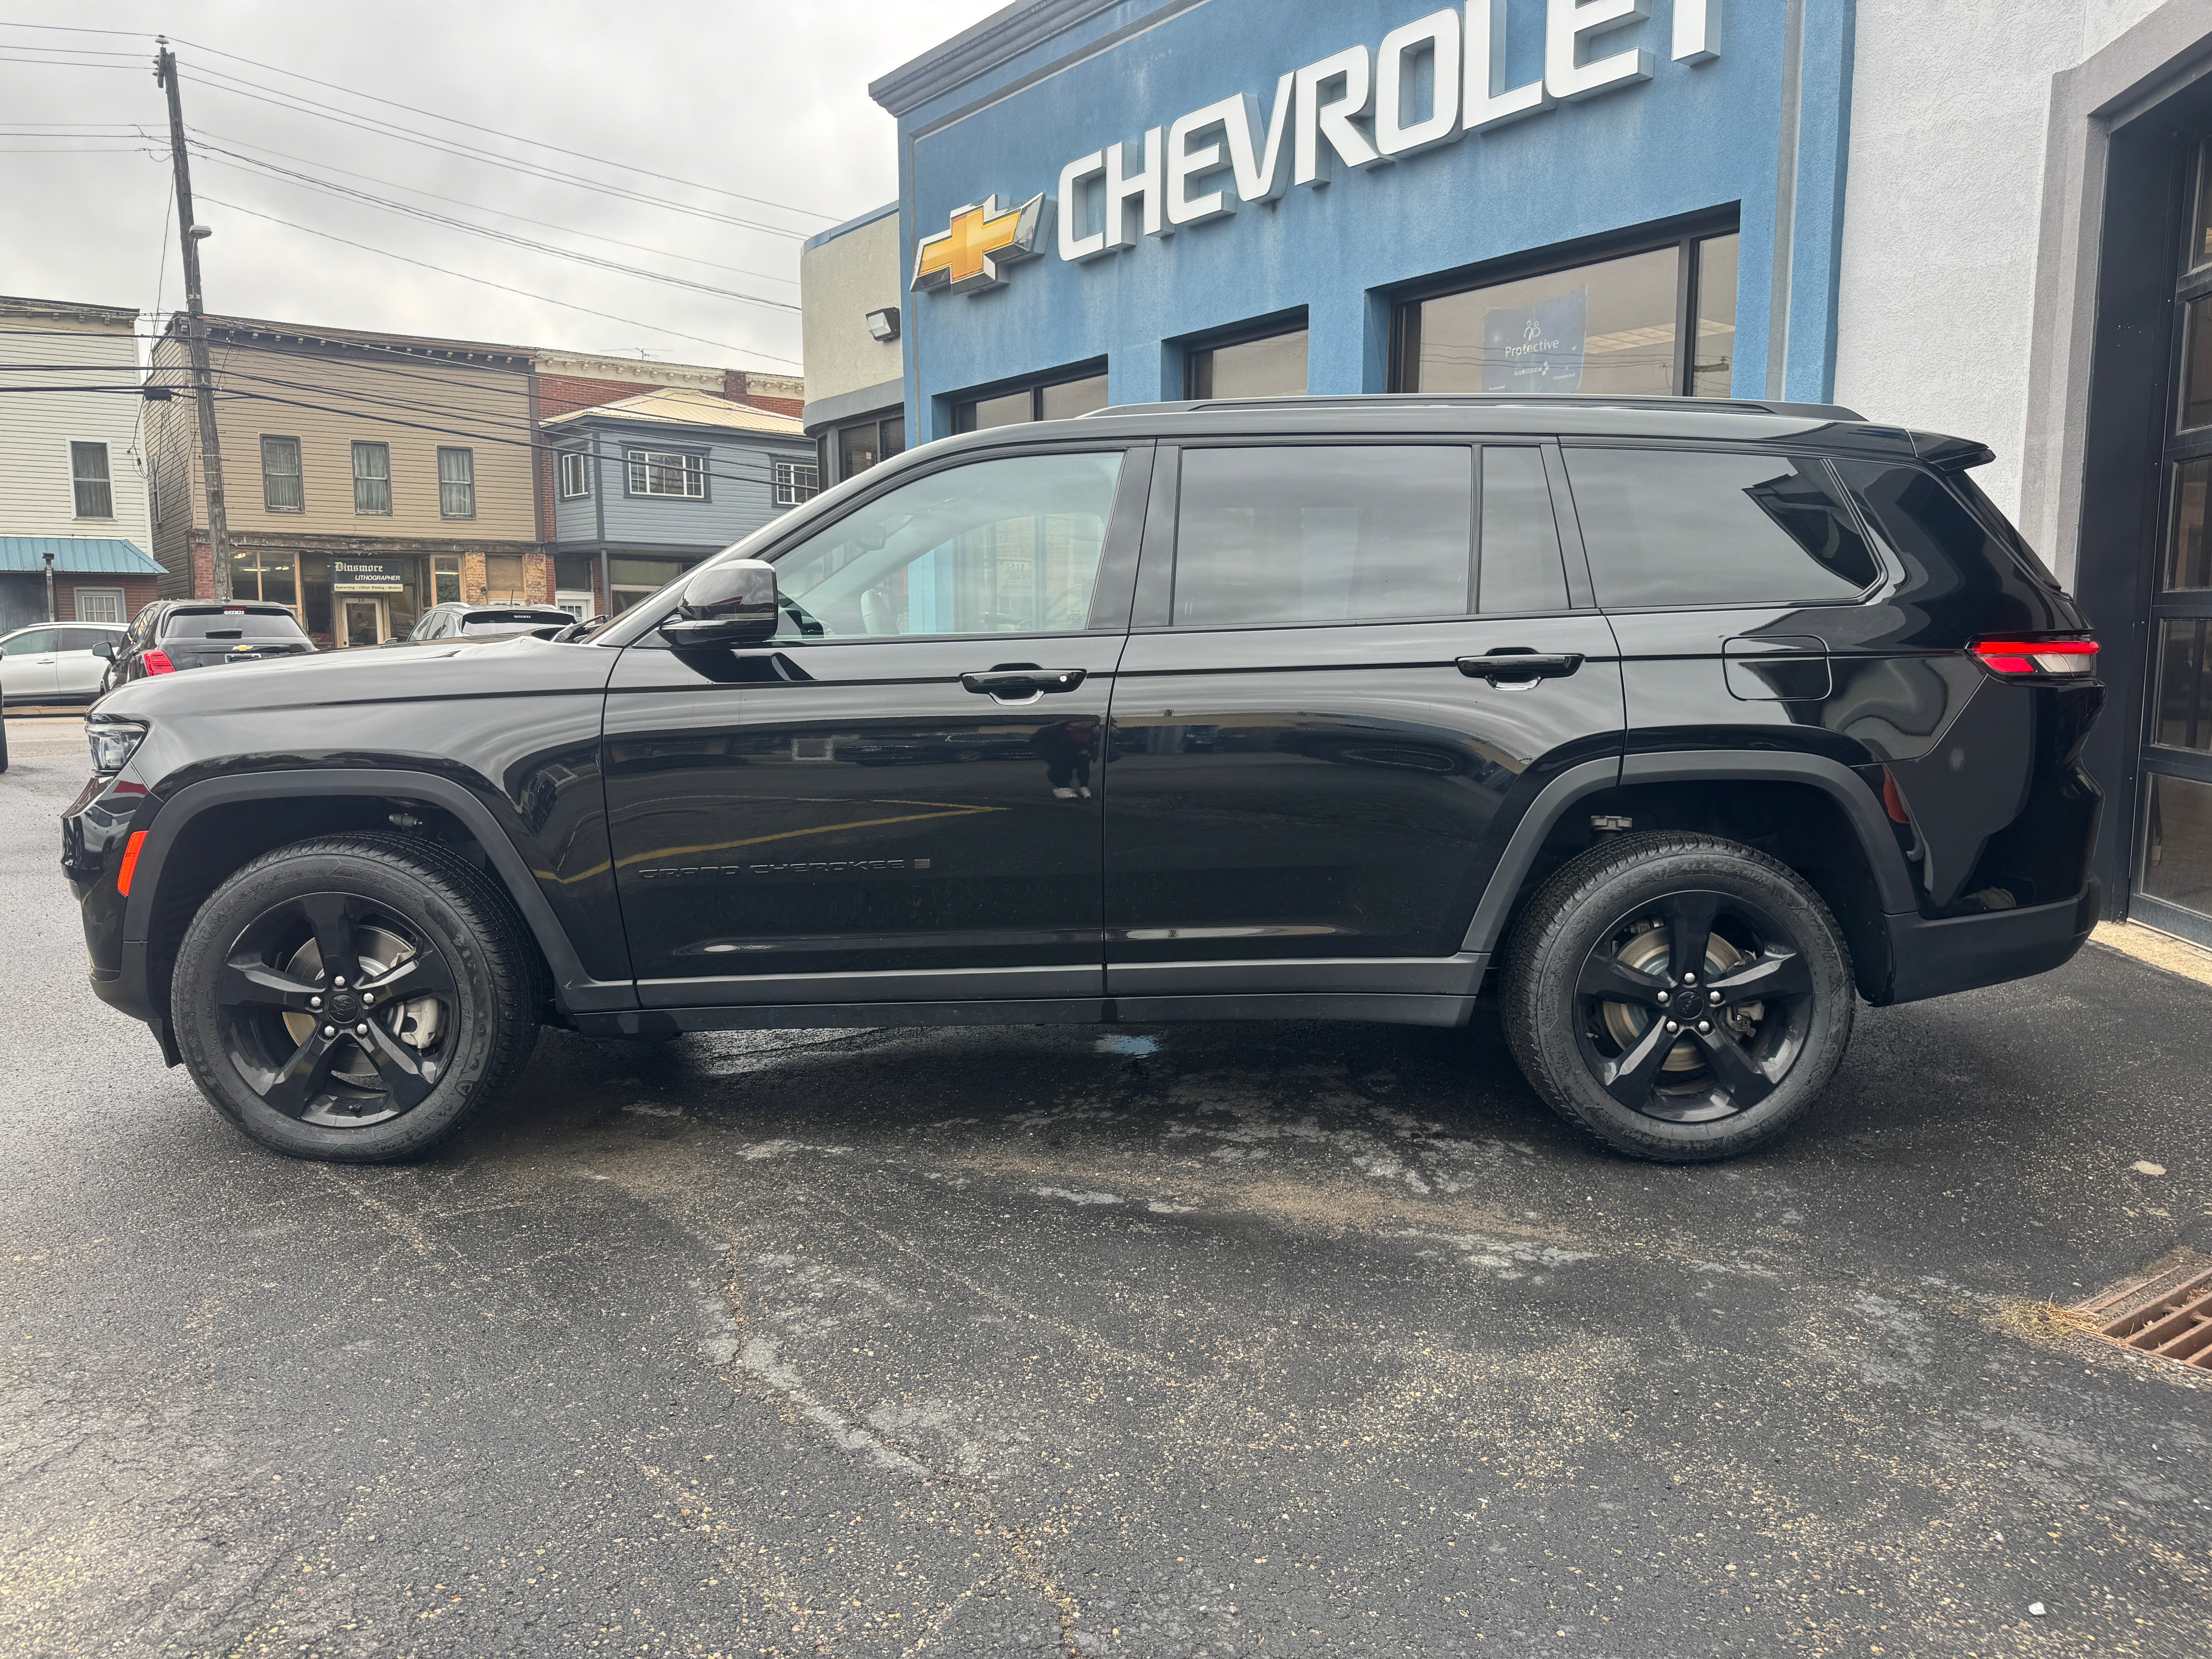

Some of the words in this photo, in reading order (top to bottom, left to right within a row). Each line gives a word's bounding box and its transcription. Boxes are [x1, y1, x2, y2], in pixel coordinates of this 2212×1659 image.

[1505, 339, 1559, 357] Protective
[1513, 366, 1543, 376] NANOXIDE
[334, 562, 383, 572] Dinsmore
[639, 866, 740, 878] GRAND
[749, 860, 905, 873] CHEROKEE
